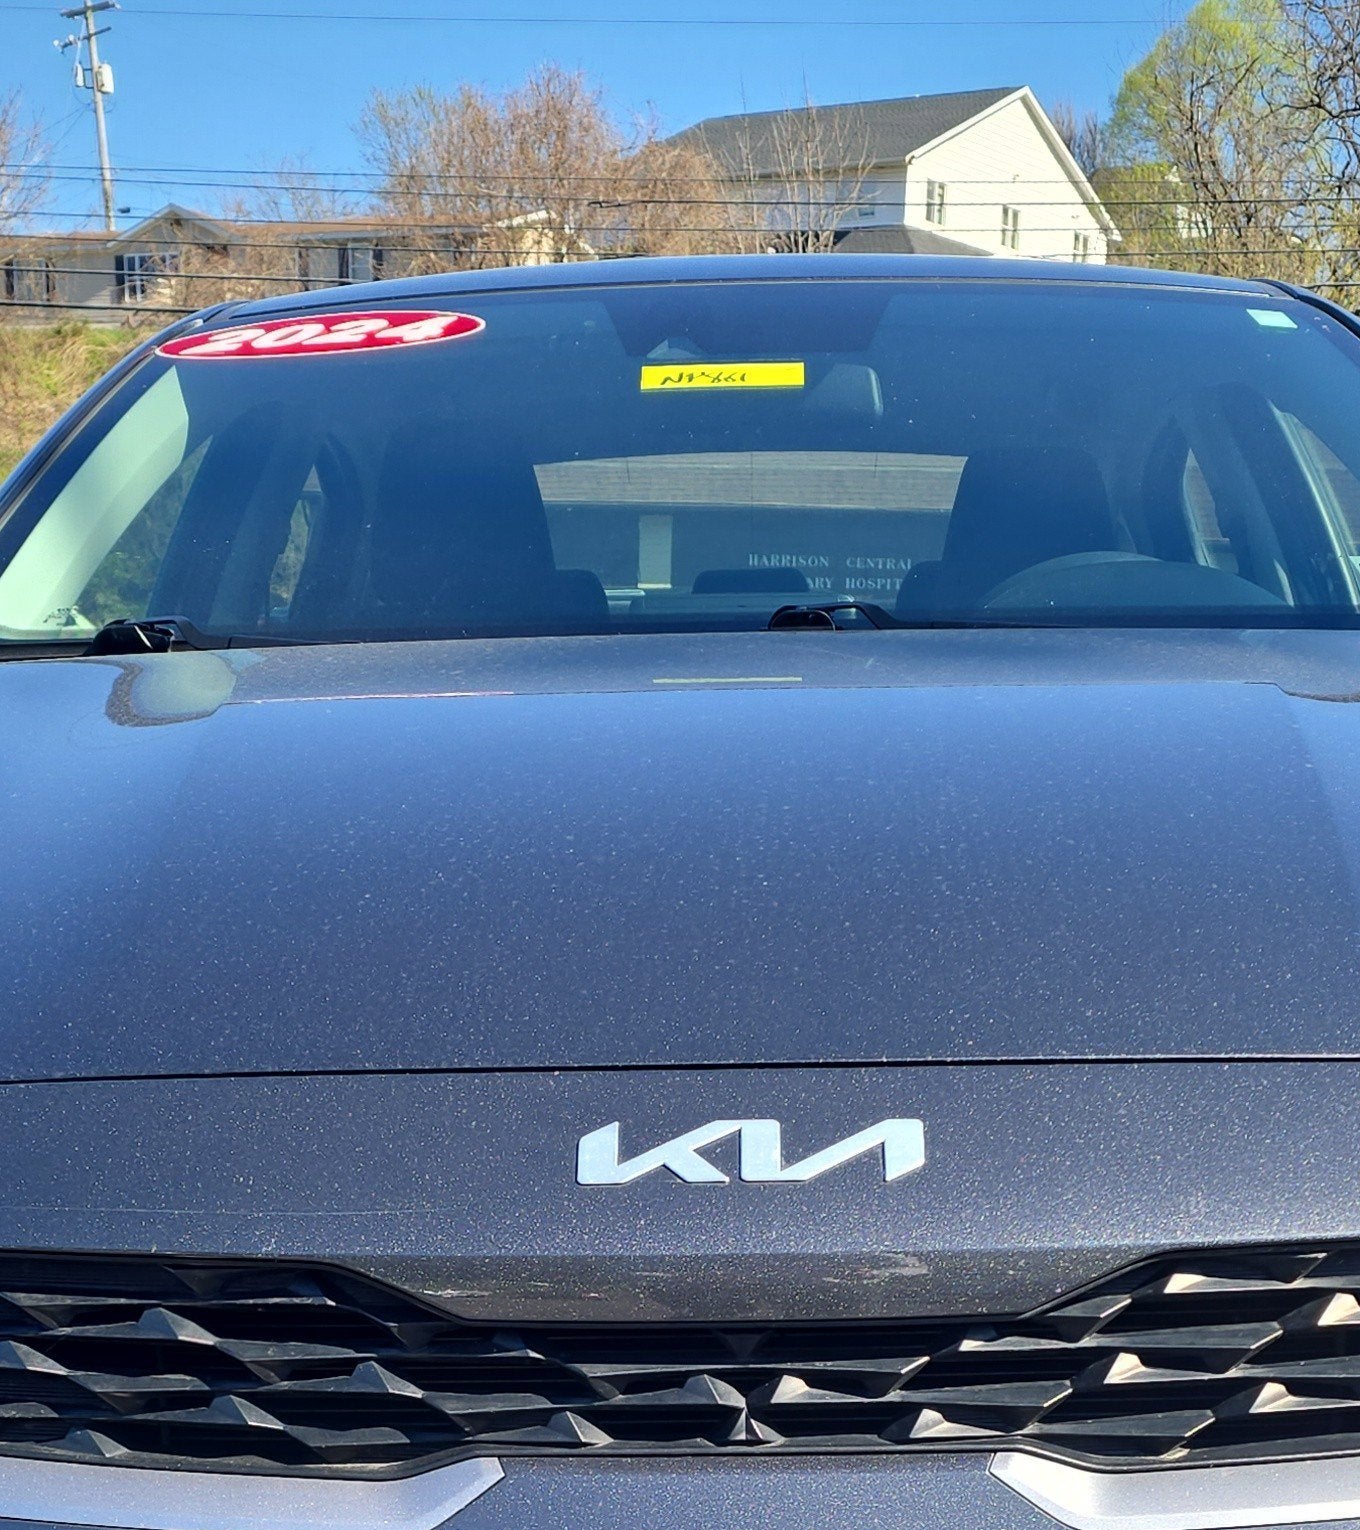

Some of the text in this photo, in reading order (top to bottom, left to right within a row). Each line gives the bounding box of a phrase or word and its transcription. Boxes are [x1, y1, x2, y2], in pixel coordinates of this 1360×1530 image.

[178, 316, 458, 354] 2024
[749, 553, 830, 567] HARRISON
[845, 577, 903, 590] HOSPIT
[576, 1118, 926, 1186] KIA
